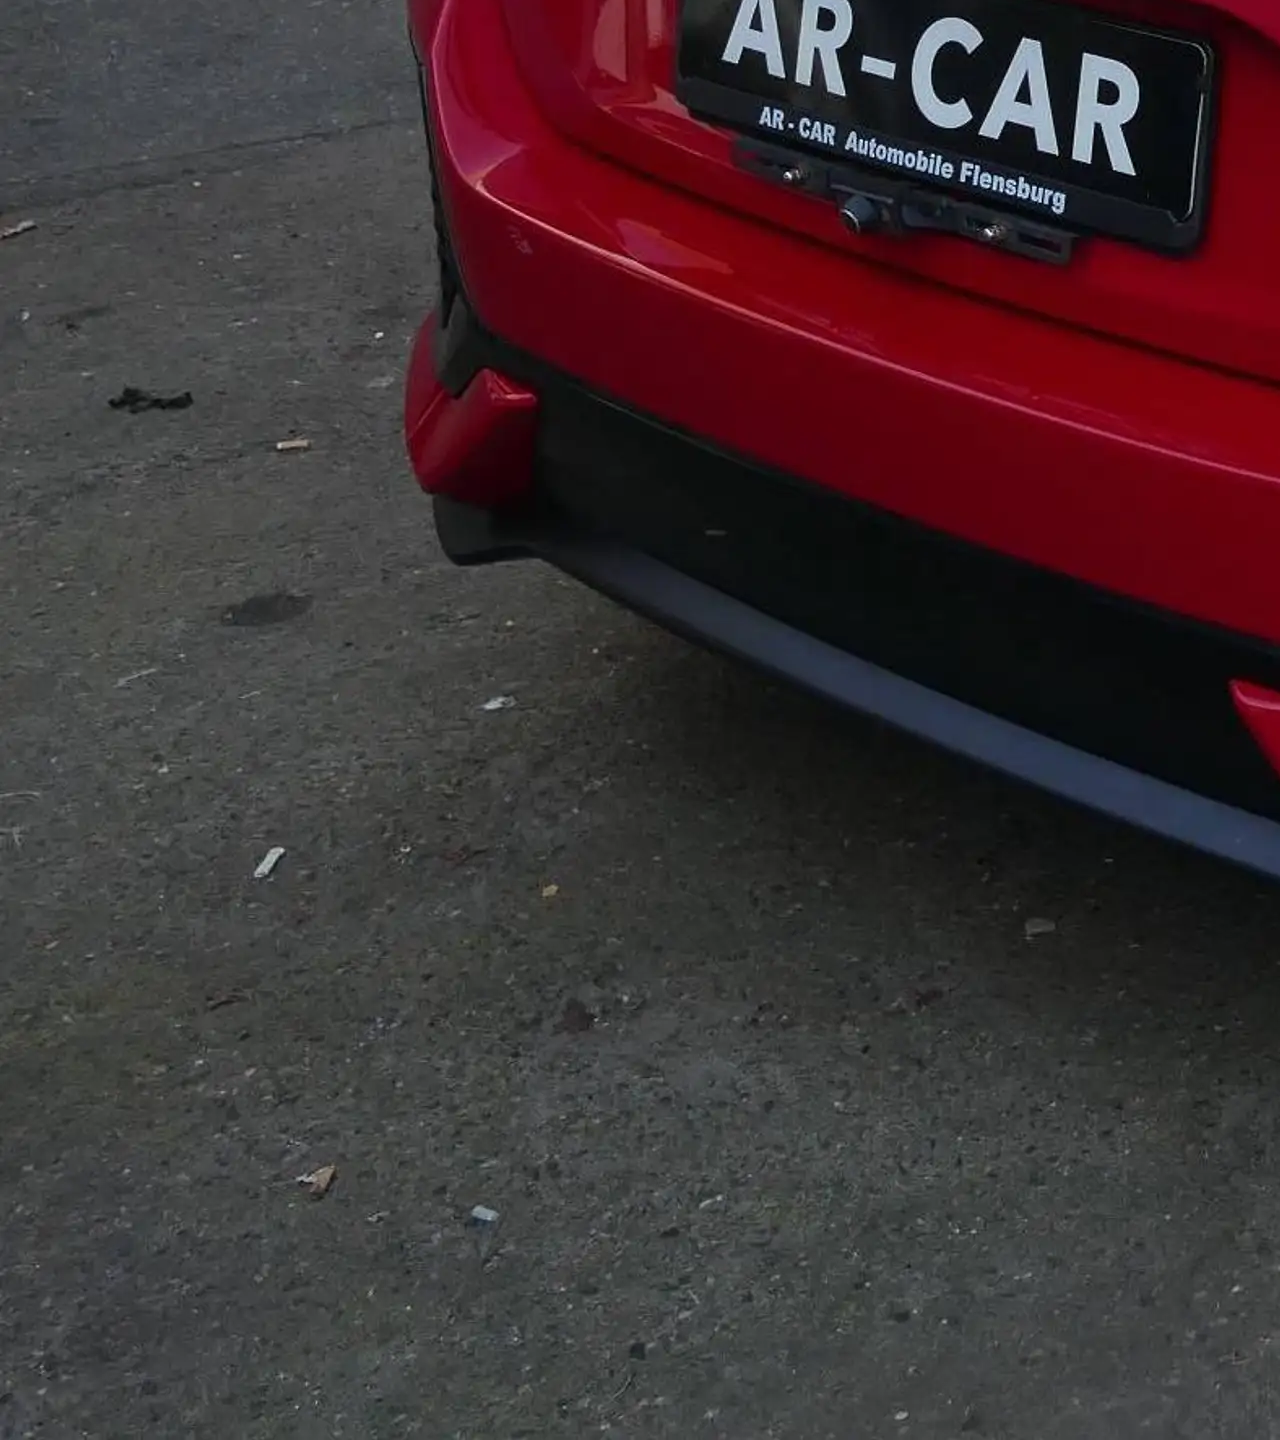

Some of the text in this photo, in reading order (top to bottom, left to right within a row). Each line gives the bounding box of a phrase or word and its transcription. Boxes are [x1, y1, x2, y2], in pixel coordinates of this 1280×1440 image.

[758, 105, 785, 131] AR
[798, 116, 836, 148] CAR
[844, 129, 955, 180] Automobile
[959, 160, 1067, 215] Flensburg
